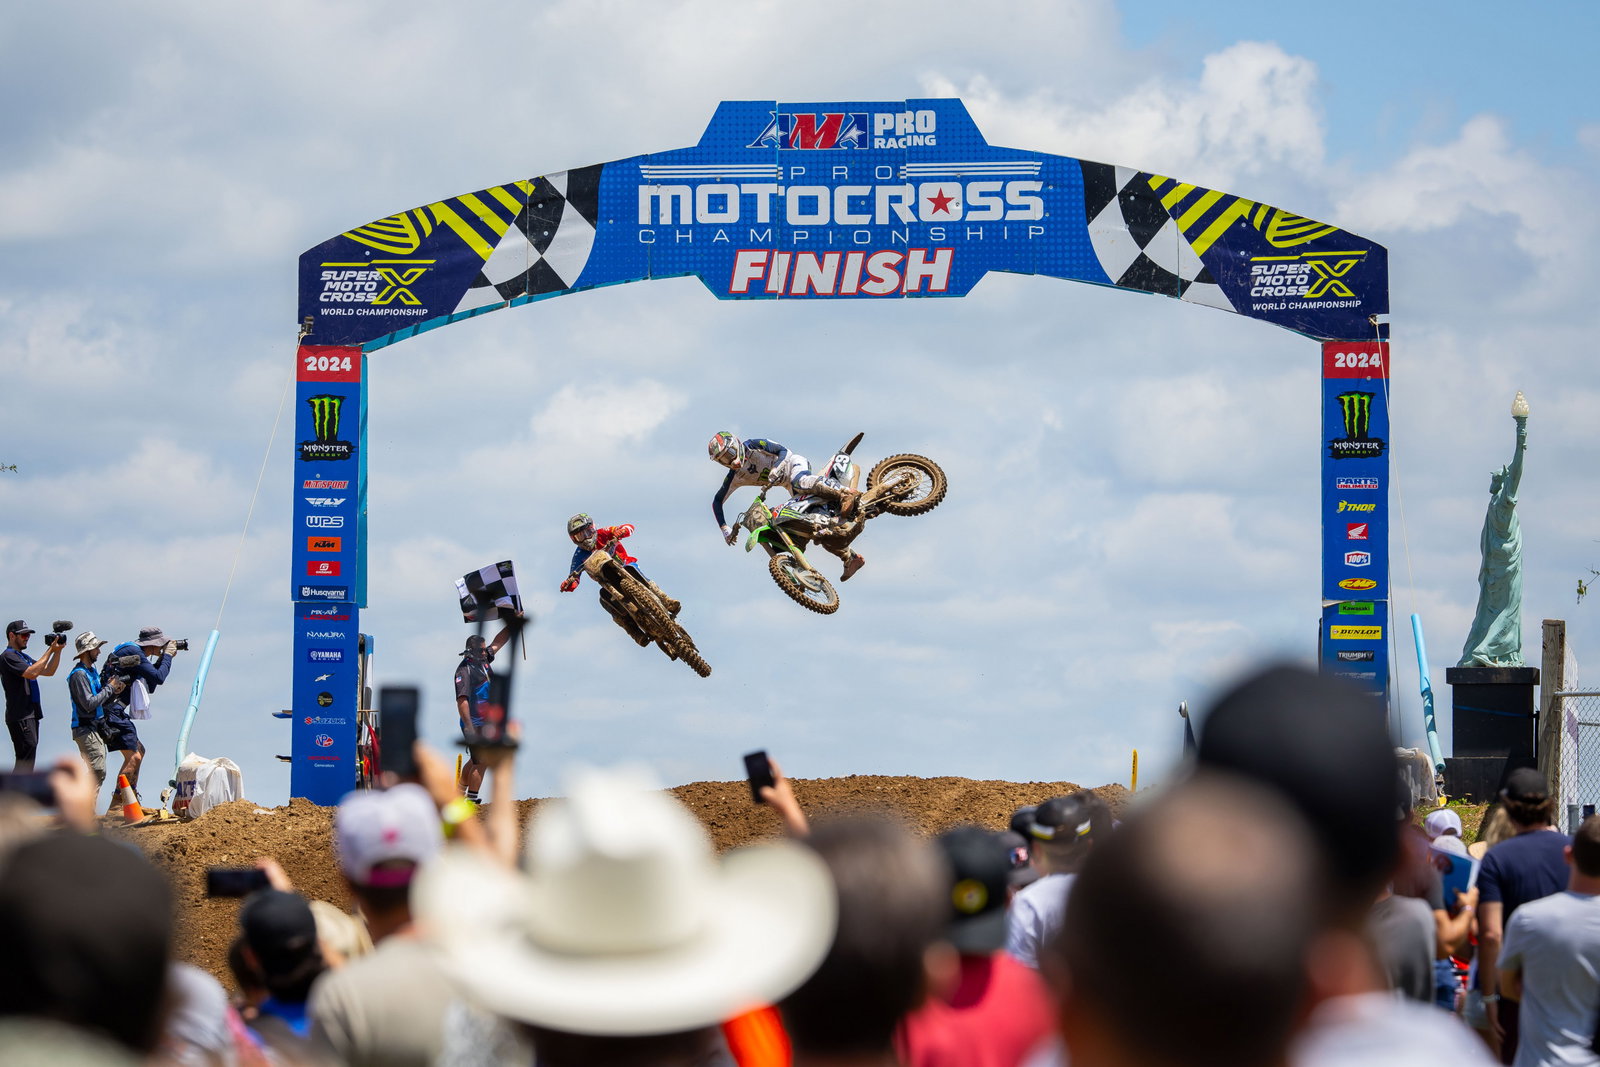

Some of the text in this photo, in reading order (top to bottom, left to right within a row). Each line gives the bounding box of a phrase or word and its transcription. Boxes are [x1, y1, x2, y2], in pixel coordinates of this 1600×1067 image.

[874, 110, 936, 136] PRO
[746, 110, 869, 150] AMA
[874, 135, 936, 149] RACING
[791, 165, 893, 180] PRO
[638, 181, 1044, 225] MOTOCROSS
[638, 226, 1045, 244] CHAMPIONSHIP
[729, 247, 955, 296] FINISH
[1250, 263, 1312, 275] SUPER
[320, 270, 380, 280] SUPER
[1255, 275, 1308, 286] MOTO
[1302, 259, 1359, 298] X
[324, 281, 377, 291] MOTO
[370, 267, 427, 305] X
[1250, 286, 1310, 297] CROSS
[319, 292, 379, 302] CROSS
[1288, 300, 1362, 310] CHAMPIONSHIP
[320, 308, 428, 316] WORLD CHAMPIONSHIP
[306, 356, 352, 371] 2024
[1334, 352, 1381, 368] 2024
[303, 445, 348, 453] MONSTER
[1333, 442, 1379, 450] MONSTER
[832, 454, 850, 474] 29
[305, 497, 346, 505] FLY
[1347, 503, 1376, 511] THOR
[306, 516, 344, 528] WPS
[1348, 554, 1368, 563] 100%
[310, 588, 345, 597] Husqvarna
[306, 630, 345, 638] NAMURA
